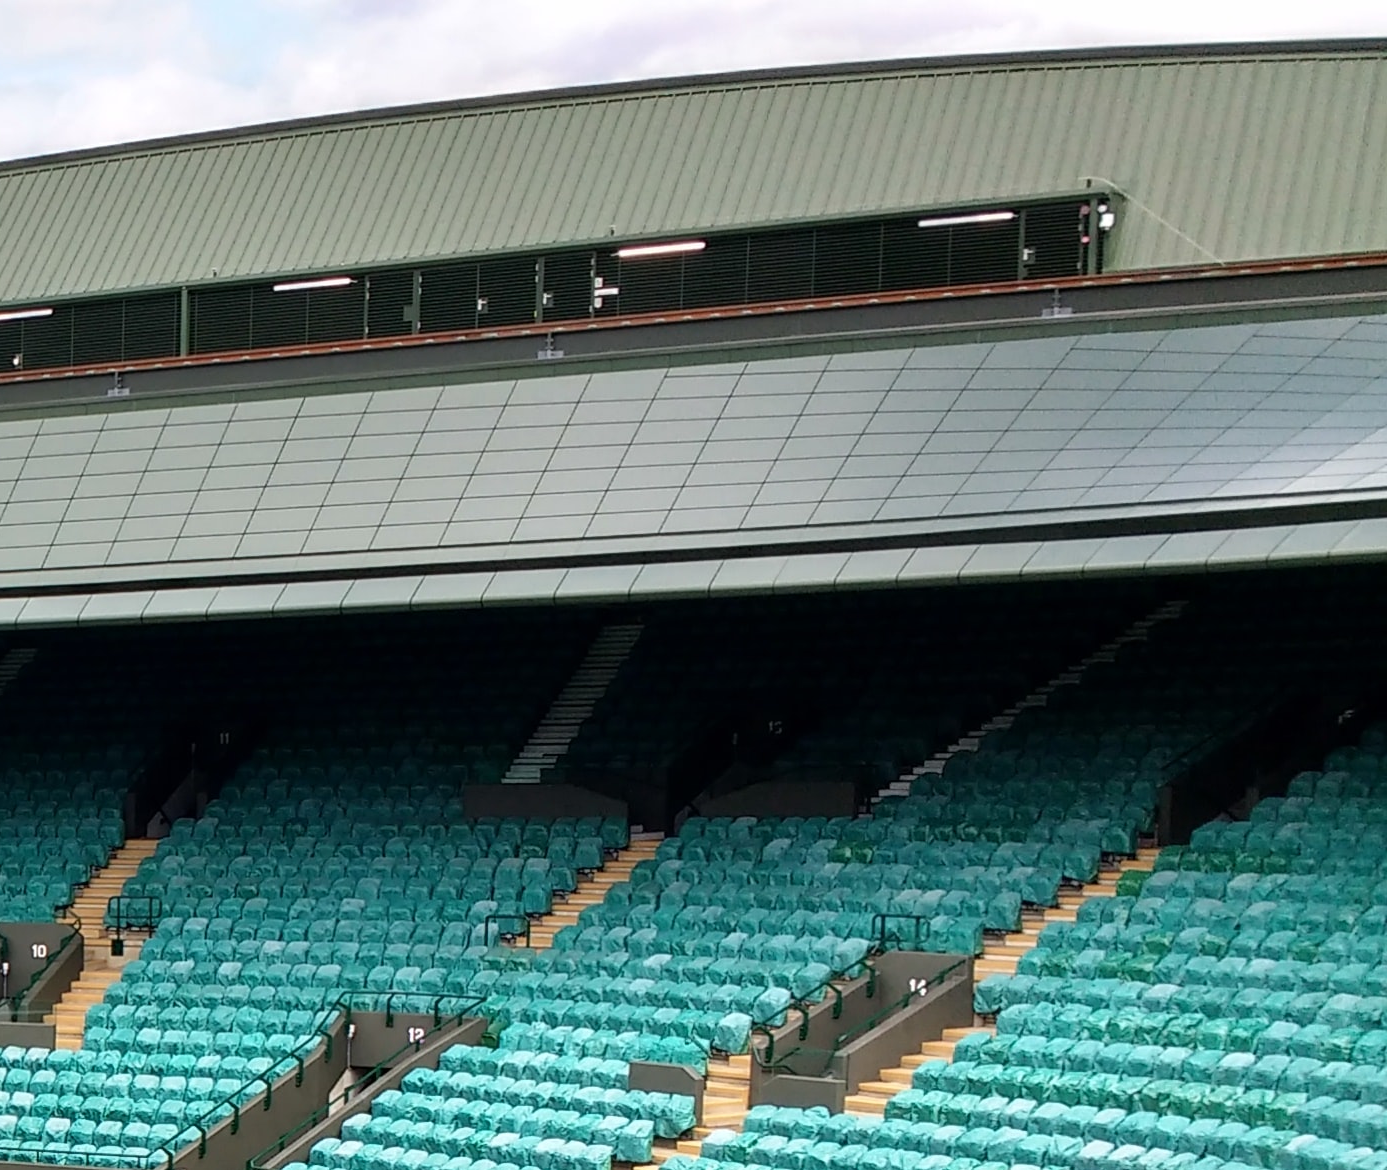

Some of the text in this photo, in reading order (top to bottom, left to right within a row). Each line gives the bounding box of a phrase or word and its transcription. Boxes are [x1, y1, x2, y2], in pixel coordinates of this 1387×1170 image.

[219, 732, 229, 745] 11
[31, 944, 48, 958] 10
[408, 1027, 425, 1043] 12
